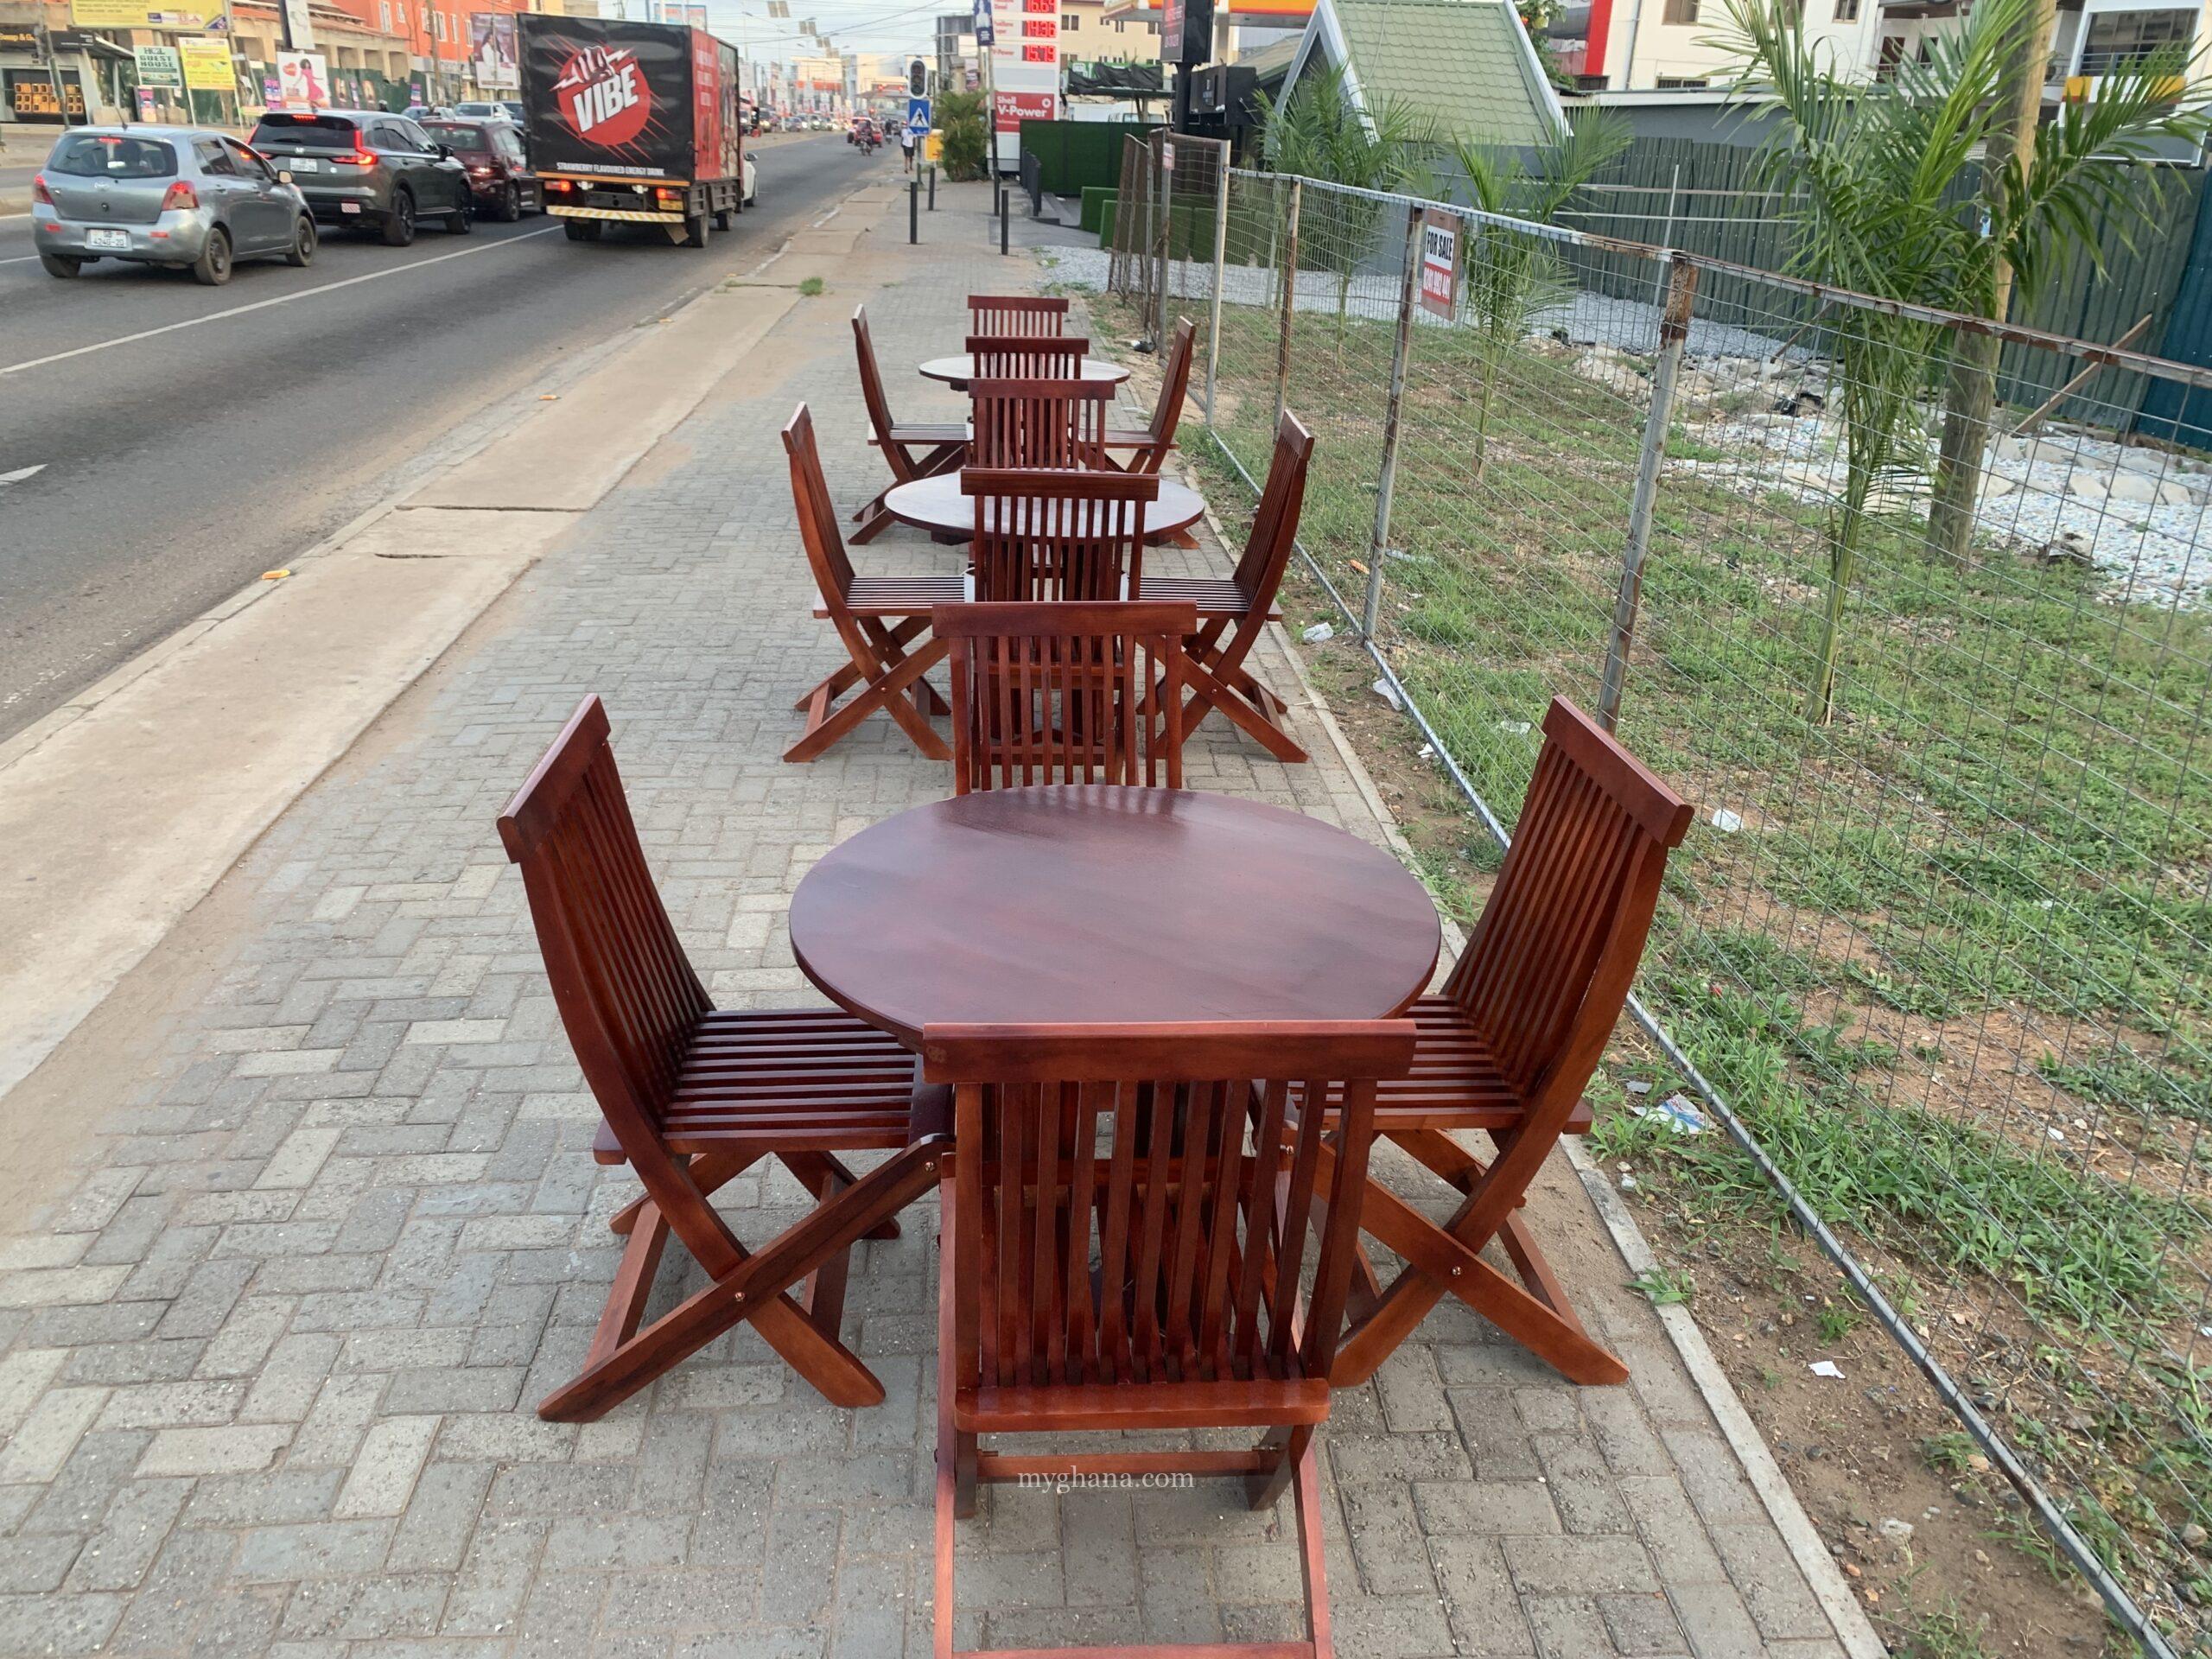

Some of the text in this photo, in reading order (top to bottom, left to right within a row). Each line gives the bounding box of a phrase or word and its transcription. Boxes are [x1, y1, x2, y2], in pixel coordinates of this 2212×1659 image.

[572, 63, 639, 132] VIBE
[996, 96, 1017, 105] Shell
[997, 105, 1047, 118] V-Power
[1427, 231, 1452, 262] FOR SALE
